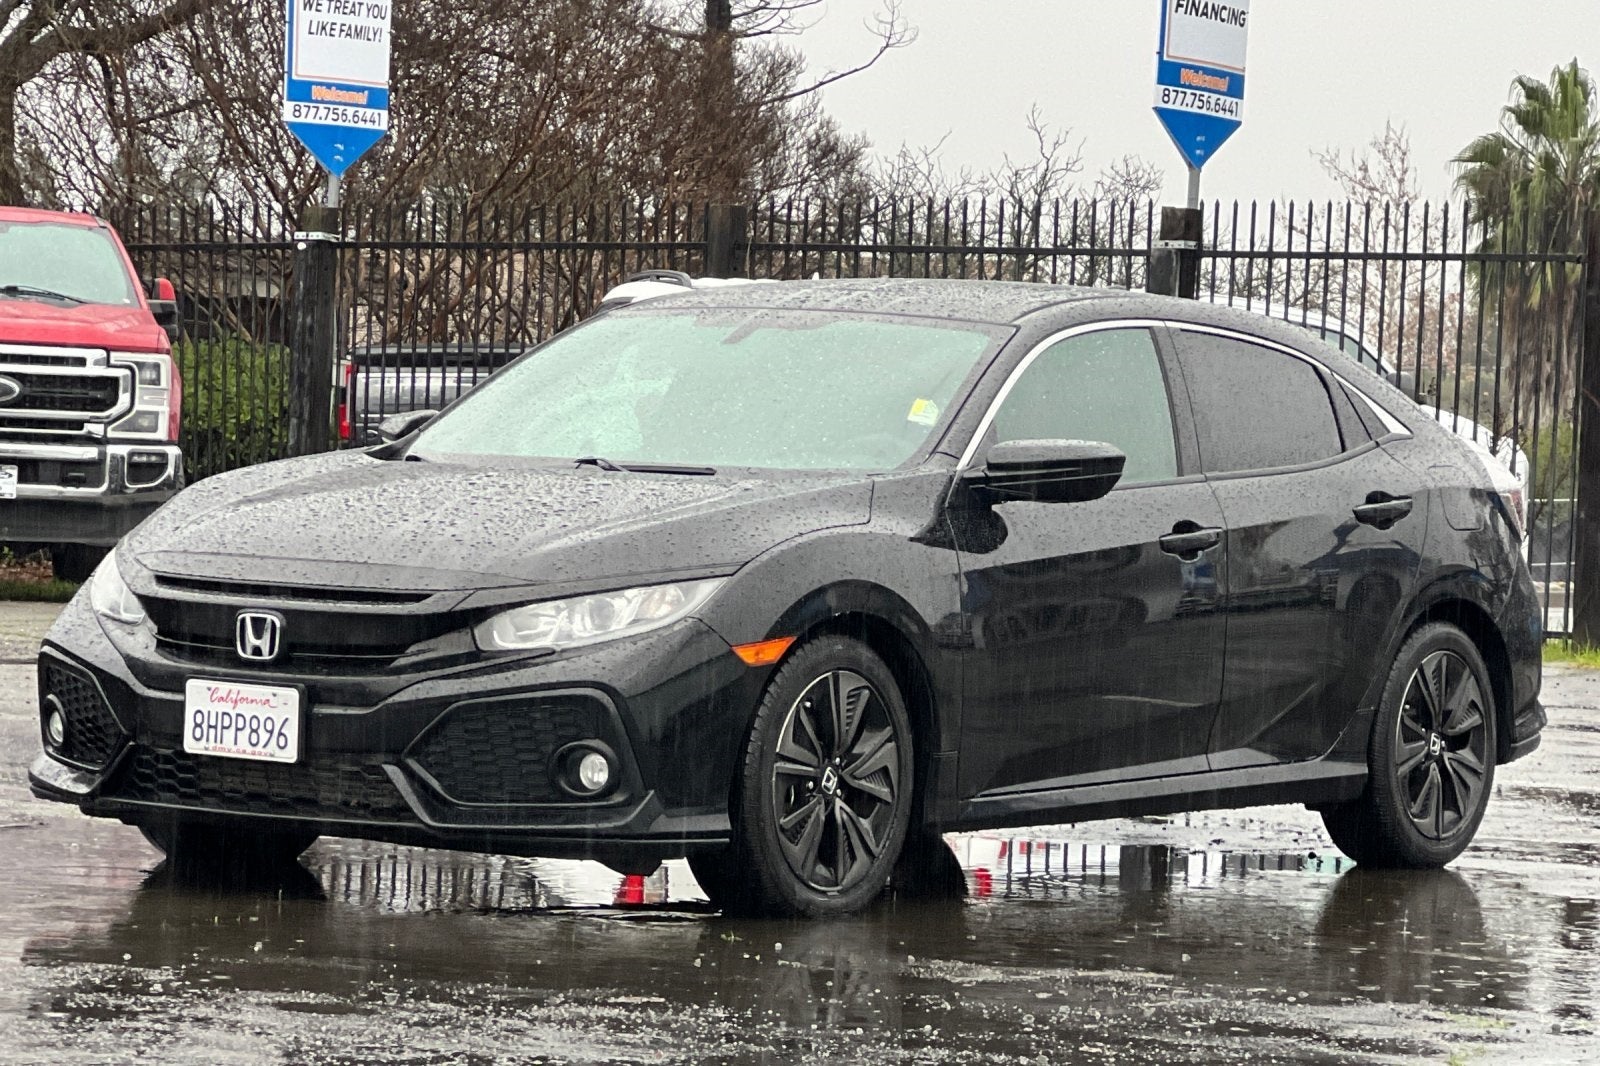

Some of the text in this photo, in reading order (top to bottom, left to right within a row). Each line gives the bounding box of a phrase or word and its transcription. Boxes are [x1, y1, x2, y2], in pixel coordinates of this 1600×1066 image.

[303, 0, 388, 20] WE TREAT YOU
[308, 20, 383, 43] LIKE FAMILY!
[1162, 88, 1239, 117] 877.756.6441
[293, 104, 382, 127] 877.756.6441
[209, 686, 278, 710] California
[192, 709, 289, 750] 8HPP896
